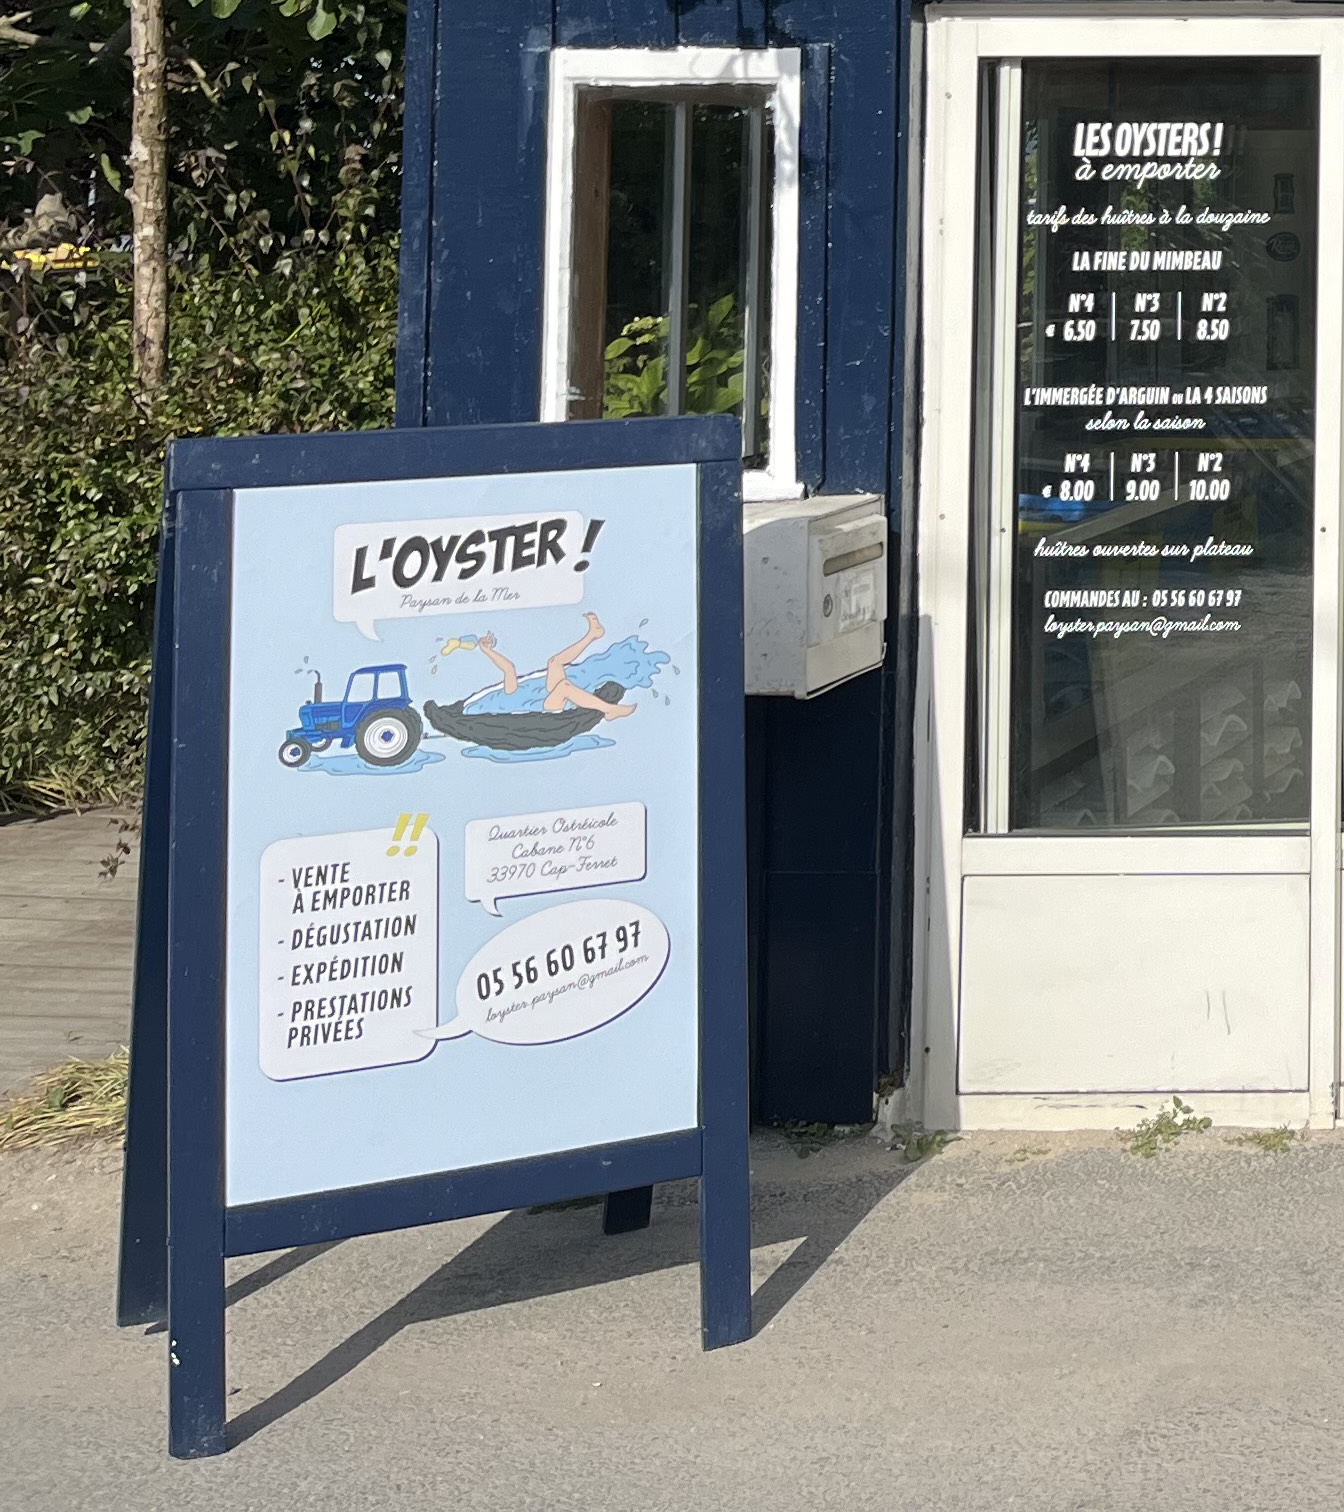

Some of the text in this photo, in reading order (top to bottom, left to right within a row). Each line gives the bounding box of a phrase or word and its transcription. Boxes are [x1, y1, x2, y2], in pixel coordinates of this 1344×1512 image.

[1073, 122, 1112, 157] LES
[1075, 157, 1221, 189] à emporter
[1027, 204, 1271, 232] tarifs des huîtres à la douzaine
[1072, 250, 1222, 271] LA FINE DU MIMBEAU
[1068, 292, 1227, 313] N°4 N°3 N°2
[1045, 319, 1230, 341] € 6.50 7.50 8.50
[1024, 384, 1103, 405] L'IMMERGÉE
[1106, 387, 1170, 405] D'ARGUIN
[1185, 387, 1201, 405] LA
[1204, 387, 1213, 404] 4
[1215, 386, 1267, 404] SAISONS
[1085, 410, 1206, 430] selon la saison
[1064, 453, 1223, 473] N°4 N°3 N°2
[1042, 479, 1231, 501] € 8.00 9.00 10.00
[350, 517, 568, 596] L'OYSTER
[1034, 536, 1254, 562] huîtres ouvertes sur plateau
[400, 587, 521, 611] Paysan de la Mer
[1044, 590, 1242, 607] COMMANDES AU 05 56 60 67 97
[1044, 614, 1241, 638] loyster.paysan@gmail.com
[488, 812, 618, 842] Quartier Ostréicole
[511, 841, 565, 860] Cabane
[291, 862, 350, 889] VENTE
[486, 856, 618, 884] 33970 Cap-Ferret
[293, 881, 411, 914] À EMPORTER
[291, 914, 417, 950] DÉGUSTATION
[291, 951, 404, 987] EXPÉDITION
[476, 919, 643, 1001] 05 56 60 67 97
[486, 954, 649, 1025] loyster.paysan@gmail.com
[291, 986, 413, 1023] PRESTATIONS
[287, 1010, 365, 1049] PRIVÉES
